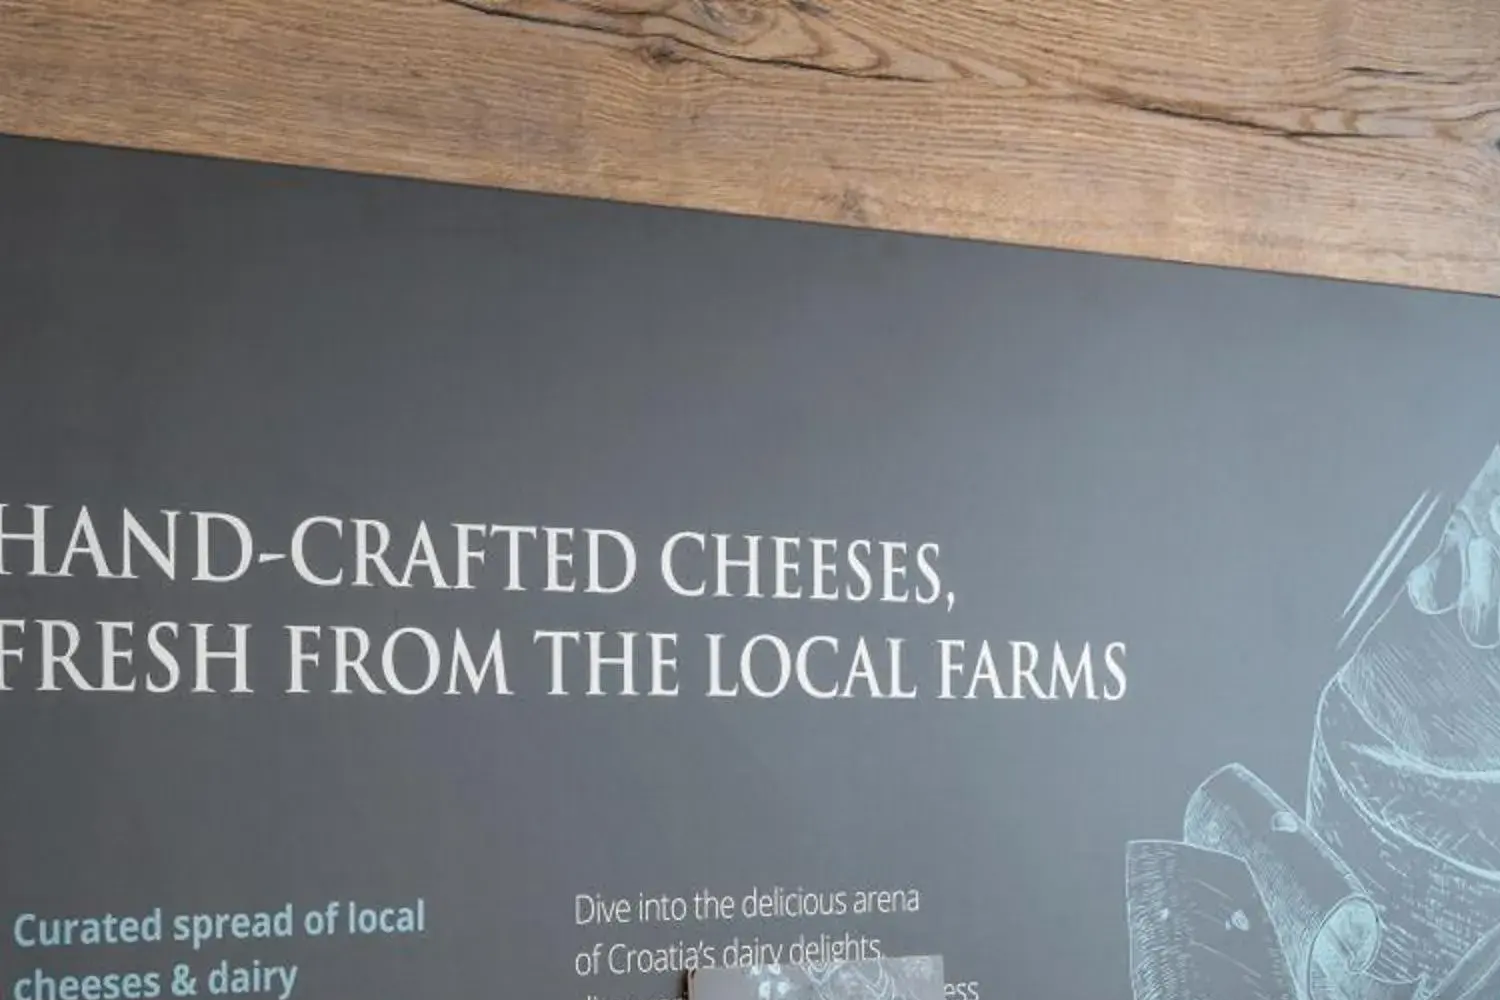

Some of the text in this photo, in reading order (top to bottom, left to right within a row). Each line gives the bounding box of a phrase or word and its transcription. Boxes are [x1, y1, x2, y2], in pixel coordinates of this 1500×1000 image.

[0, 504, 954, 611] HAND-CRAFTED CHEESES,
[0, 620, 1126, 700] FRESH FROM THE LOCAL FARMS
[15, 899, 424, 949] Curated spread of local
[576, 887, 919, 924] Dive into the delicious arena
[172, 964, 196, 995] &
[209, 960, 297, 1000] dairy
[576, 943, 602, 975] of
[608, 940, 716, 974] Croatia's
